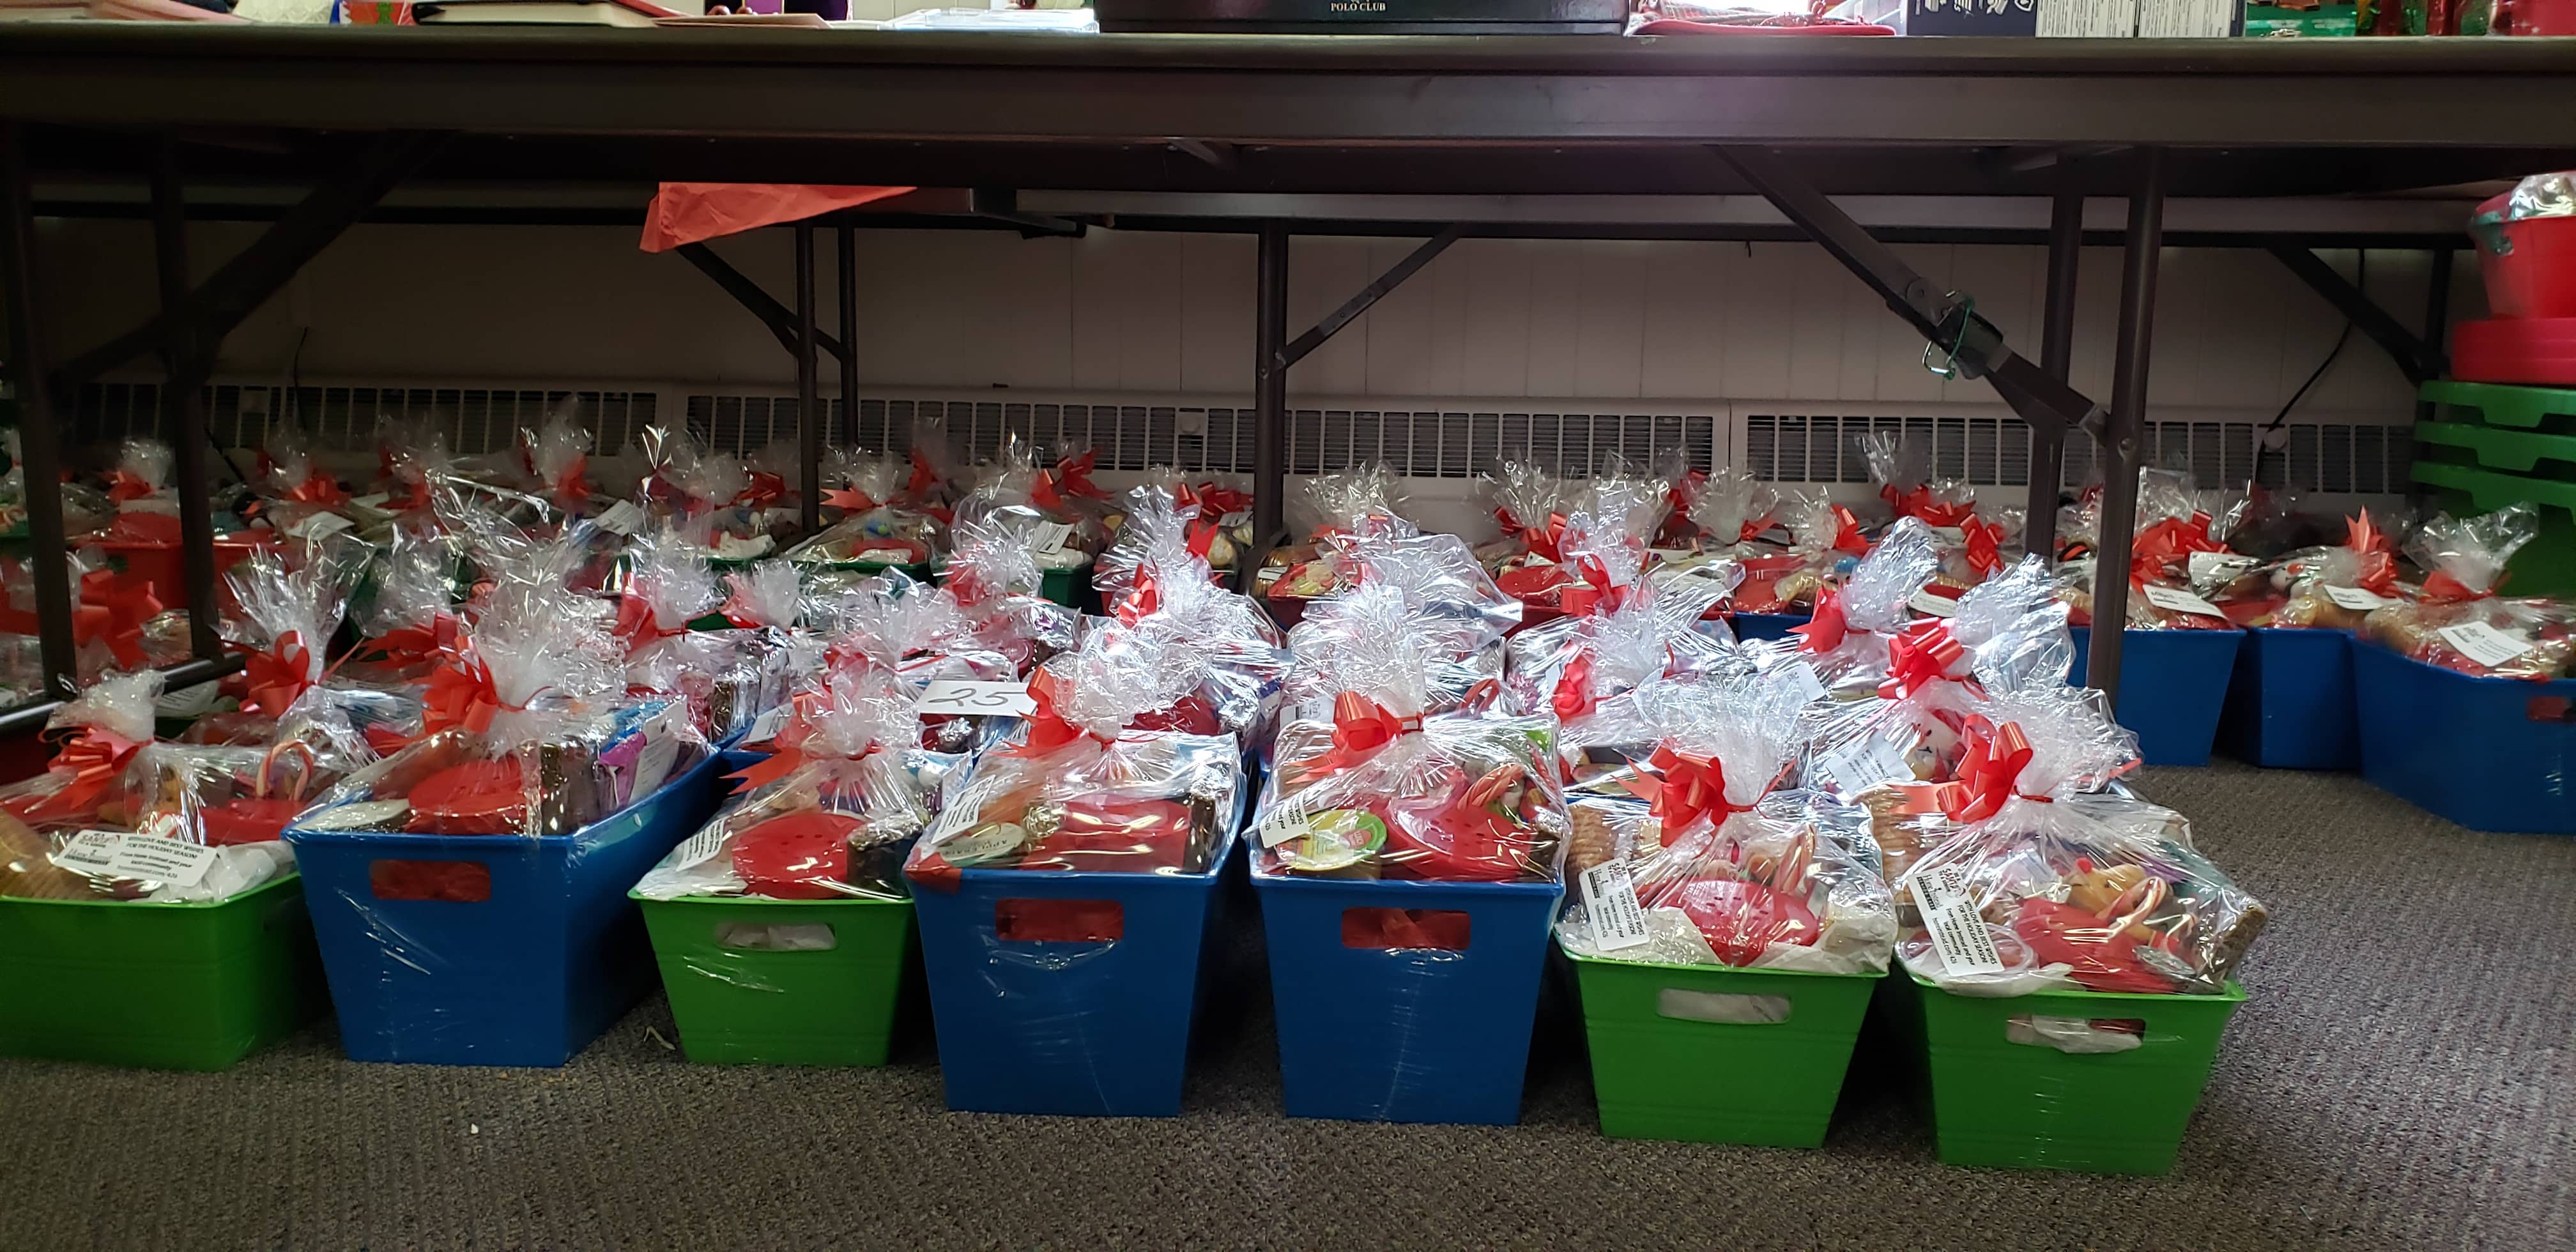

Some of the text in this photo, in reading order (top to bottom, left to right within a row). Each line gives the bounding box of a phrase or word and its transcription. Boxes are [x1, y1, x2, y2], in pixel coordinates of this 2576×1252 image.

[1331, 3, 1386, 11] POLO CLUB
[928, 687, 1026, 707] 25
[1942, 868, 1959, 889] SANTA
[1946, 908, 1955, 917] From
[1951, 918, 1960, 929] Home
[1956, 931, 1968, 947] Instead
[1966, 956, 1975, 966] your
[1965, 900, 1997, 964] WITH LOVE AND BEST WISHES
[1965, 922, 1979, 943] HOLIDAY
[1946, 931, 1961, 955] community
